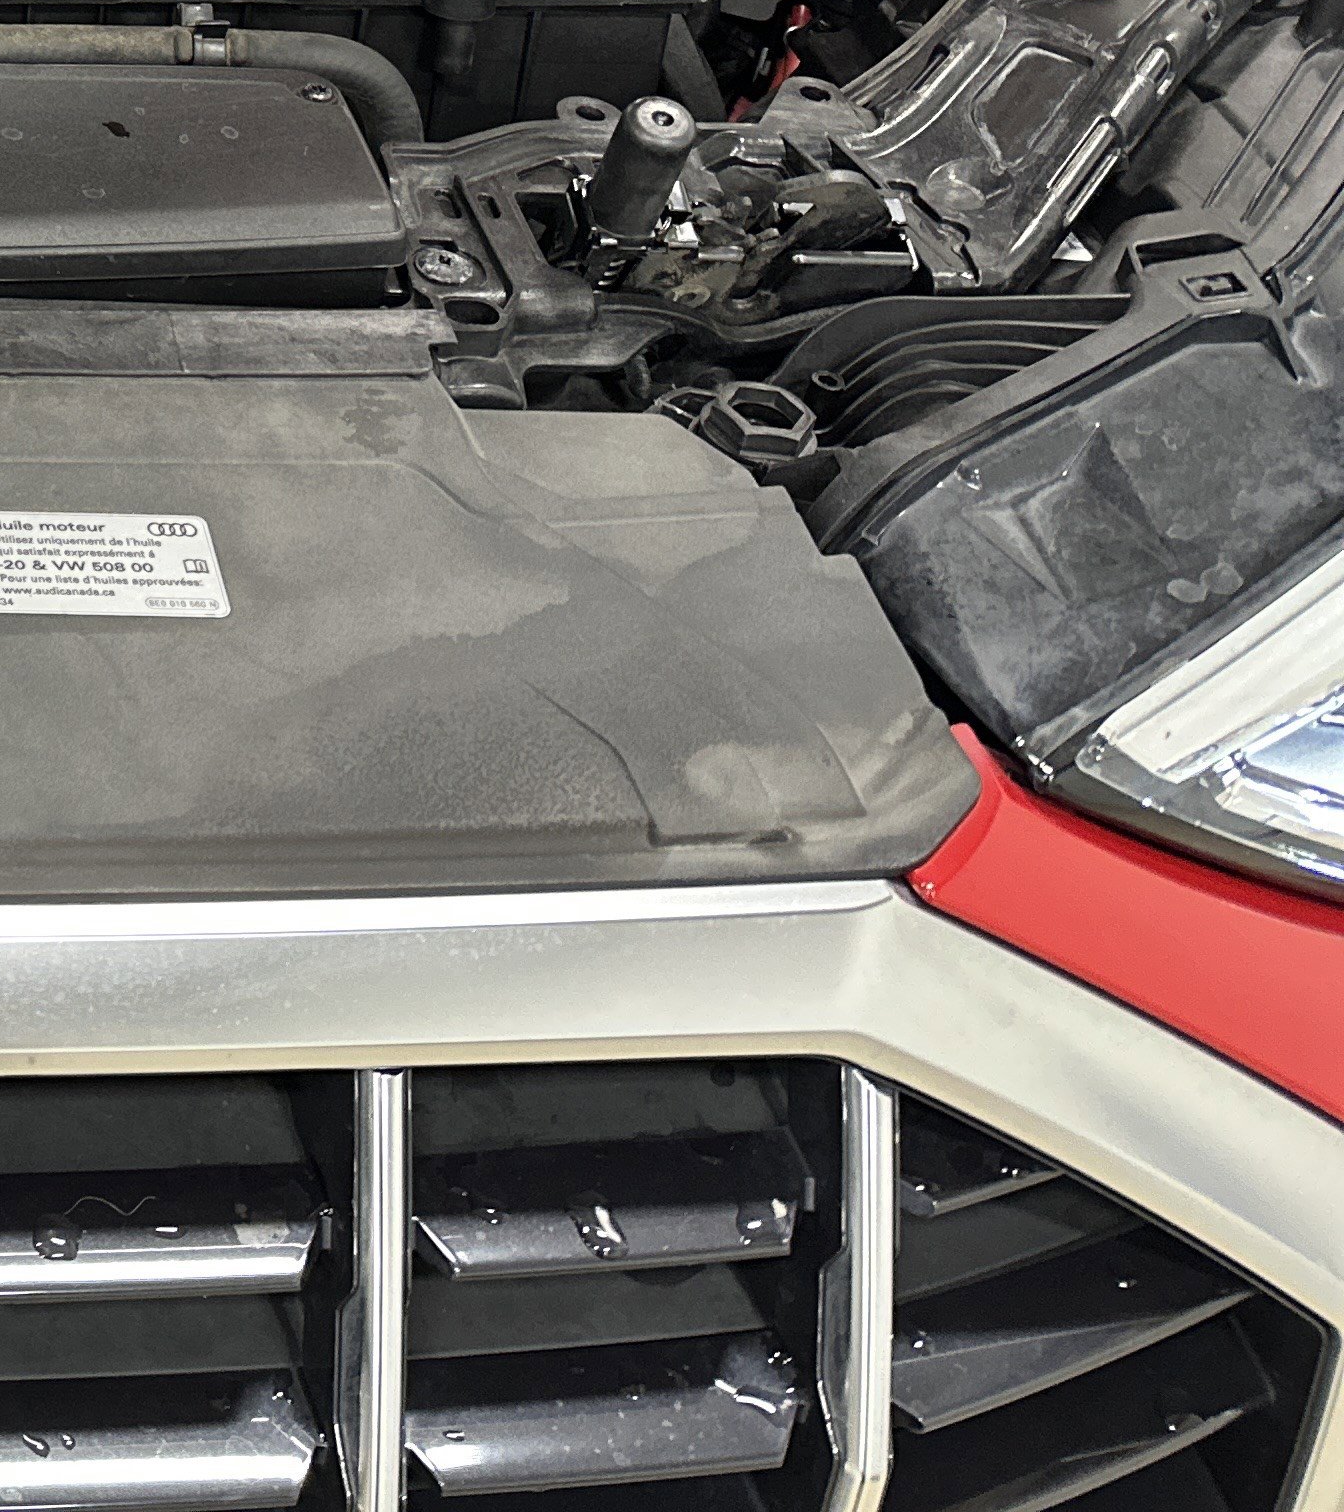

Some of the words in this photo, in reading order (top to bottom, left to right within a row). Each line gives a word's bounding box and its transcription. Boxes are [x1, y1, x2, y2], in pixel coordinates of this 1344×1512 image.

[38, 522, 105, 532] moteur
[36, 536, 106, 546] uniquement
[108, 536, 124, 546] de
[16, 546, 61, 557] satisfait
[63, 548, 145, 558] expressément
[31, 559, 47, 571] &
[51, 560, 86, 571] VW
[91, 561, 126, 572] 508
[130, 562, 154, 573] 00
[0, 572, 27, 583] Pour
[30, 575, 53, 584] une
[54, 574, 80, 584] liste
[2, 586, 115, 597] www.audicanada.ca
